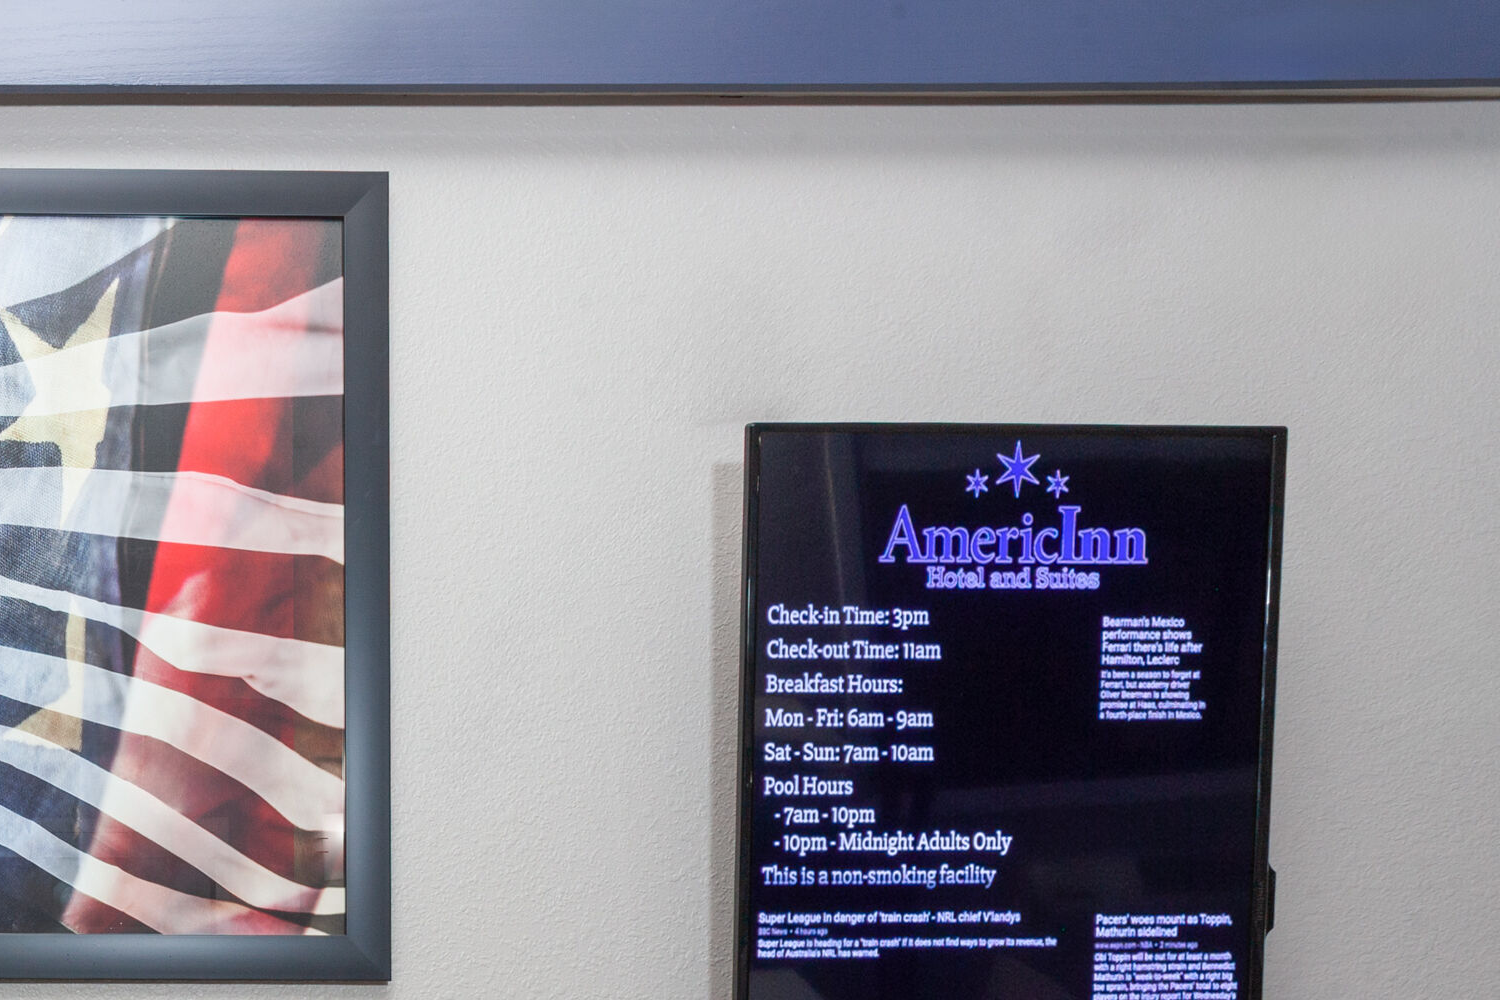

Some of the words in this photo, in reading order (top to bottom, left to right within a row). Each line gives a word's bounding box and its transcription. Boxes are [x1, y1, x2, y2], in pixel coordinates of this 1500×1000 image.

[878, 504, 1148, 564] AmericInn
[926, 565, 986, 589] Hotel
[989, 567, 1032, 588] and
[1035, 565, 1101, 590] Suites
[767, 604, 841, 625] Check-in
[843, 605, 890, 625] Time:
[892, 609, 930, 630] 3pm
[1102, 628, 1161, 641] performance
[1162, 628, 1192, 640] shows
[766, 638, 850, 659] Check-out
[853, 639, 900, 659] Time:
[902, 643, 942, 660] 11am
[765, 672, 845, 693] Breakfast
[847, 674, 903, 693] Hours:
[764, 708, 804, 727] Mon
[816, 708, 844, 727] Fri:
[847, 708, 885, 727] 6am
[896, 710, 934, 730] 9am
[764, 742, 792, 762] Sat
[803, 742, 841, 762] Sun:
[843, 745, 880, 764] 7am
[890, 744, 934, 762] 10am
[763, 775, 800, 796] Pool
[802, 776, 854, 796] Hours
[783, 807, 820, 826] 7am
[831, 806, 876, 829] 10pm
[782, 834, 828, 857] 10pm
[838, 830, 914, 857] Midnight
[916, 830, 970, 851] Adults
[972, 830, 1013, 857] Only
[762, 865, 798, 886] This
[800, 866, 816, 885] is
[818, 869, 829, 885] a
[831, 864, 937, 889] non-smoking
[939, 863, 997, 889] facility
[759, 912, 786, 925] Super
[787, 912, 821, 925] League
[823, 912, 832, 923] in
[833, 912, 866, 925] danger
[867, 911, 878, 923] of
[880, 911, 902, 923] 'train
[903, 911, 931, 922] crash'
[937, 911, 957, 922] NRL
[958, 911, 982, 923] chief
